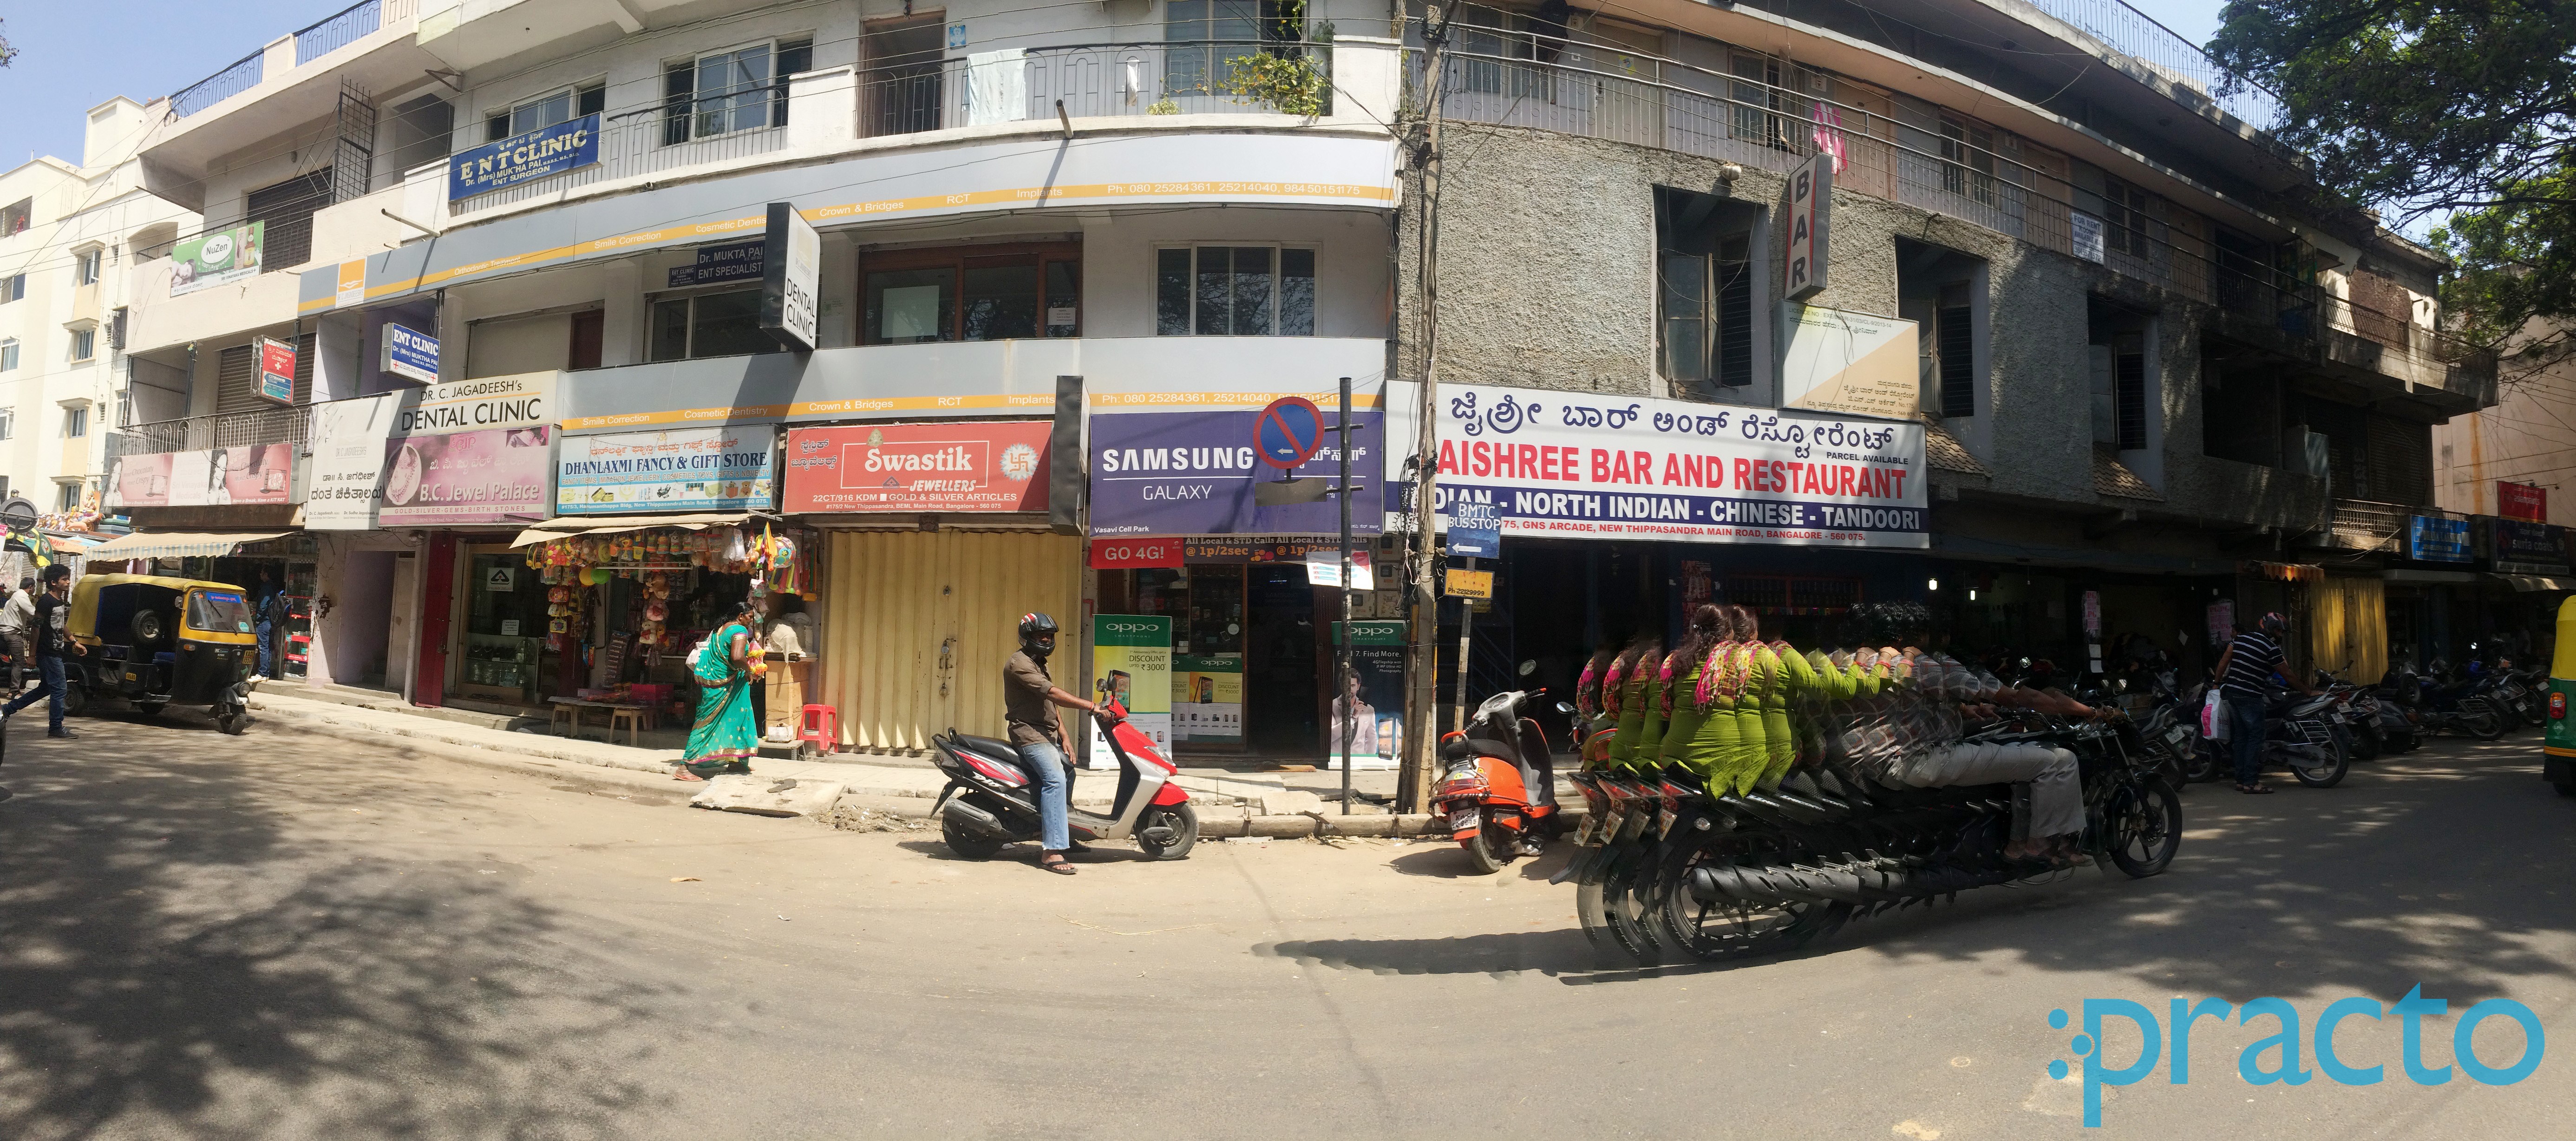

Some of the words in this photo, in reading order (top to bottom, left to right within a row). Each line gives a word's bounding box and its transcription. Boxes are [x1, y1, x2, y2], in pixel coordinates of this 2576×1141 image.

[513, 130, 588, 165] CLINIC
[466, 178, 475, 187] Dr.
[477, 172, 495, 184] (Mrs)
[492, 177, 507, 186] ENT
[510, 166, 550, 181] SURGEON
[594, 238, 616, 249] Smile
[619, 231, 661, 245] Correction
[696, 221, 735, 233] Cosmetic
[819, 206, 851, 217] Crown
[864, 201, 904, 212] Bridges
[947, 193, 971, 205] RCT
[1017, 189, 1063, 199] Implants
[1130, 183, 1150, 193] 080
[1154, 183, 1215, 193] 25284361,
[1218, 183, 1280, 194] 25214040,
[2087, 219, 2101, 231] RENT
[1791, 170, 1810, 289] BAR
[206, 244, 228, 255] NuZen
[700, 254, 711, 263] Dr.
[714, 249, 745, 261] MUKTA
[748, 246, 763, 256] PAI
[454, 262, 488, 275] Orthodontic
[490, 256, 521, 267] Treatment
[698, 269, 714, 279] ENT
[716, 262, 763, 276] SPECIALIST
[787, 277, 815, 318] DENTAL
[787, 304, 813, 339] CLINIC
[393, 329, 411, 346] ENT
[412, 336, 438, 356] CLINIC
[400, 348, 411, 358] (Mrs)
[412, 352, 430, 363] MUKTHA
[421, 391, 435, 401] DR.
[439, 389, 448, 399] C.
[452, 380, 522, 398] JAGADEESH's
[402, 406, 467, 431] DENTAL
[475, 398, 541, 424] CLINIC
[608, 415, 649, 424] Correction
[685, 410, 725, 419] Cosmetic
[727, 407, 768, 416] Dentistry
[809, 402, 840, 411] Crown
[855, 400, 894, 410] Bridges
[938, 397, 962, 406] RCT
[1008, 395, 1055, 405] Implants
[1124, 394, 1146, 403] 080
[1149, 393, 1210, 404] 25284361,
[1213, 393, 1274, 404] 25214040,
[1563, 404, 1641, 429] ಬಾರ್
[565, 459, 632, 476] DHANLAXMI
[637, 457, 674, 471] FANCY
[677, 456, 687, 469] &
[692, 454, 719, 468] GIFT
[724, 452, 767, 467] STORE
[865, 446, 973, 472] Swastik
[1103, 447, 1254, 472] SAMSUNG
[1826, 452, 1860, 461] PARCEL
[1863, 454, 1909, 465] AVAILABLE
[599, 475, 626, 484] IMITATION
[627, 474, 661, 483] JEWELLERY,
[662, 472, 697, 480] COSMETICS,
[698, 471, 715, 479] TOYS,
[741, 469, 770, 477] NOVELTY
[1437, 439, 1580, 481] AISHREE
[1591, 449, 1654, 485] BAR
[1662, 452, 1723, 490] AND
[1734, 458, 1907, 499] RESTAURANT
[311, 486, 333, 500] ದಂತ
[420, 483, 444, 502] B.C.
[446, 482, 488, 502] Jewel
[491, 481, 540, 501] Palace
[909, 480, 976, 492] JEWELLERS
[1143, 485, 1212, 500] GALAXY
[1458, 504, 1495, 518] BMTC
[1516, 491, 1606, 517] NORTH
[1609, 495, 1690, 520] INDIAN
[1711, 500, 1804, 525] CHINESE
[1822, 506, 1920, 530] TANDOORI
[1523, 521, 1546, 530] GNS
[1550, 522, 1596, 533] ARCADE,
[1599, 524, 1623, 533] NEW
[1626, 525, 1704, 535] THIPPASANDRA
[1736, 528, 1764, 538] ROAD,
[1767, 531, 1822, 539] BANGALORE
[1105, 547, 1131, 560] GO
[1136, 546, 1164, 559] 4G!
[1186, 546, 1196, 557] @
[1200, 546, 1249, 557] 1p/2sec
[1277, 546, 1286, 556] @
[2534, 541, 2554, 552] coats
[1106, 623, 1159, 632] oppo
